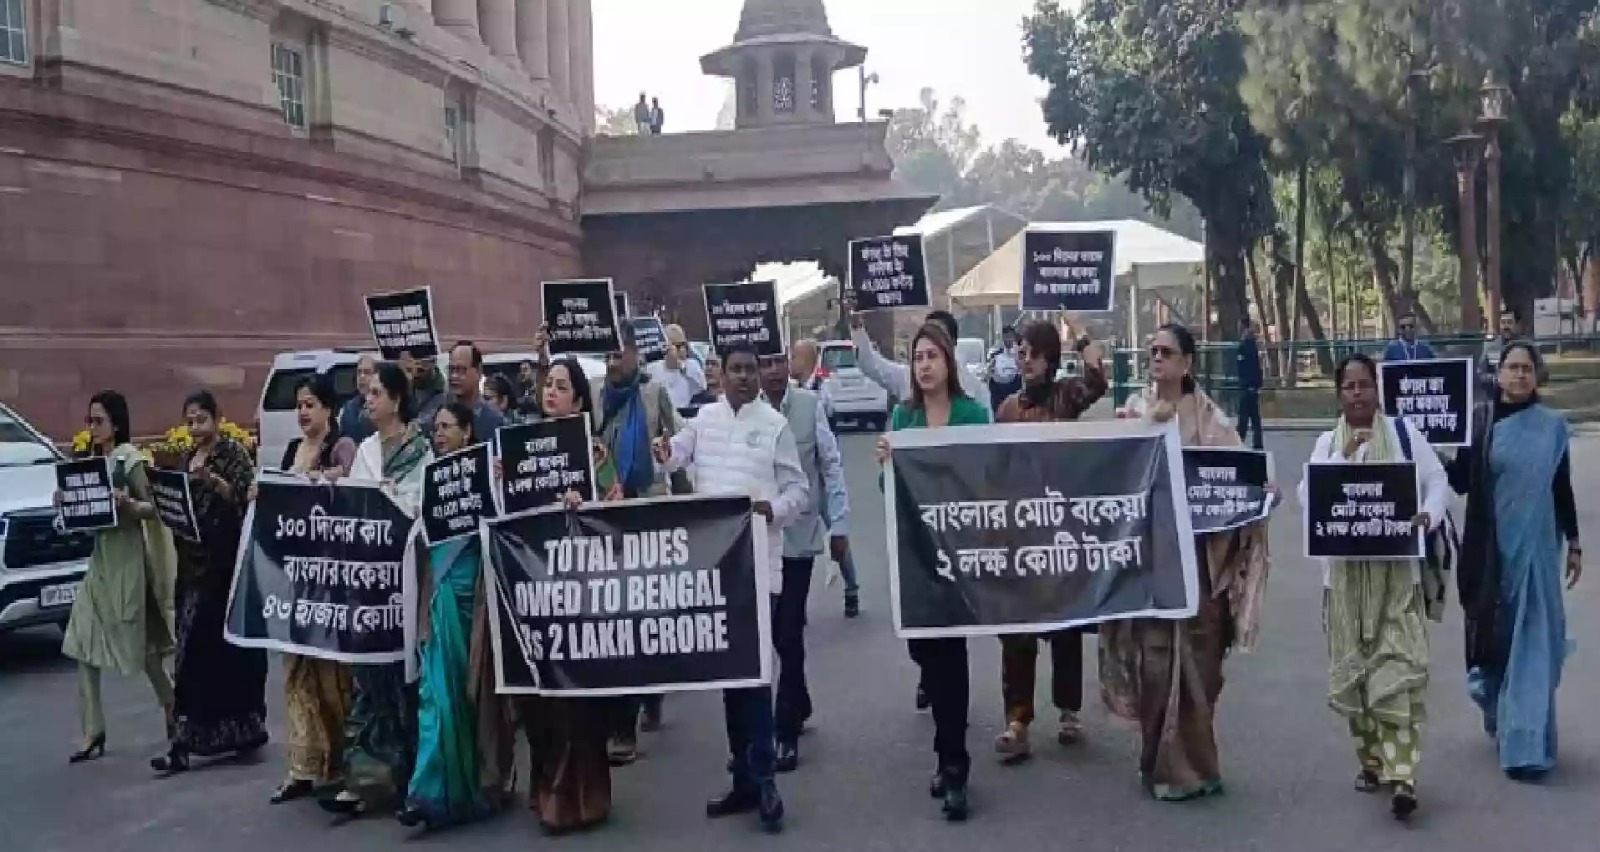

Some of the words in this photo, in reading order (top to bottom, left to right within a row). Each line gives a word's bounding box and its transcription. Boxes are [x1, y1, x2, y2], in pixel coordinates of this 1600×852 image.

[275, 514, 307, 540] ১০০
[309, 505, 357, 544] দিনের
[918, 500, 1009, 532] বাংলার
[1014, 484, 1067, 527] মোট
[1069, 491, 1147, 524] বকেয়া
[283, 555, 340, 586] বাংলার
[341, 561, 400, 590] বকেয়া
[543, 534, 618, 576] TOTAL
[623, 526, 689, 570] DUES
[936, 548, 956, 582] ২
[957, 547, 1009, 579] লক্ষ
[1014, 531, 1082, 577] কোটি
[1081, 530, 1143, 572] টাকা
[262, 594, 292, 620] ৪৩
[294, 599, 350, 631] হাজার
[514, 579, 583, 617] OWED
[588, 578, 621, 614] TO
[626, 568, 727, 612] BENGAL
[548, 621, 564, 661] 2
[568, 619, 636, 661] LAKH
[639, 611, 730, 656] CRORE
